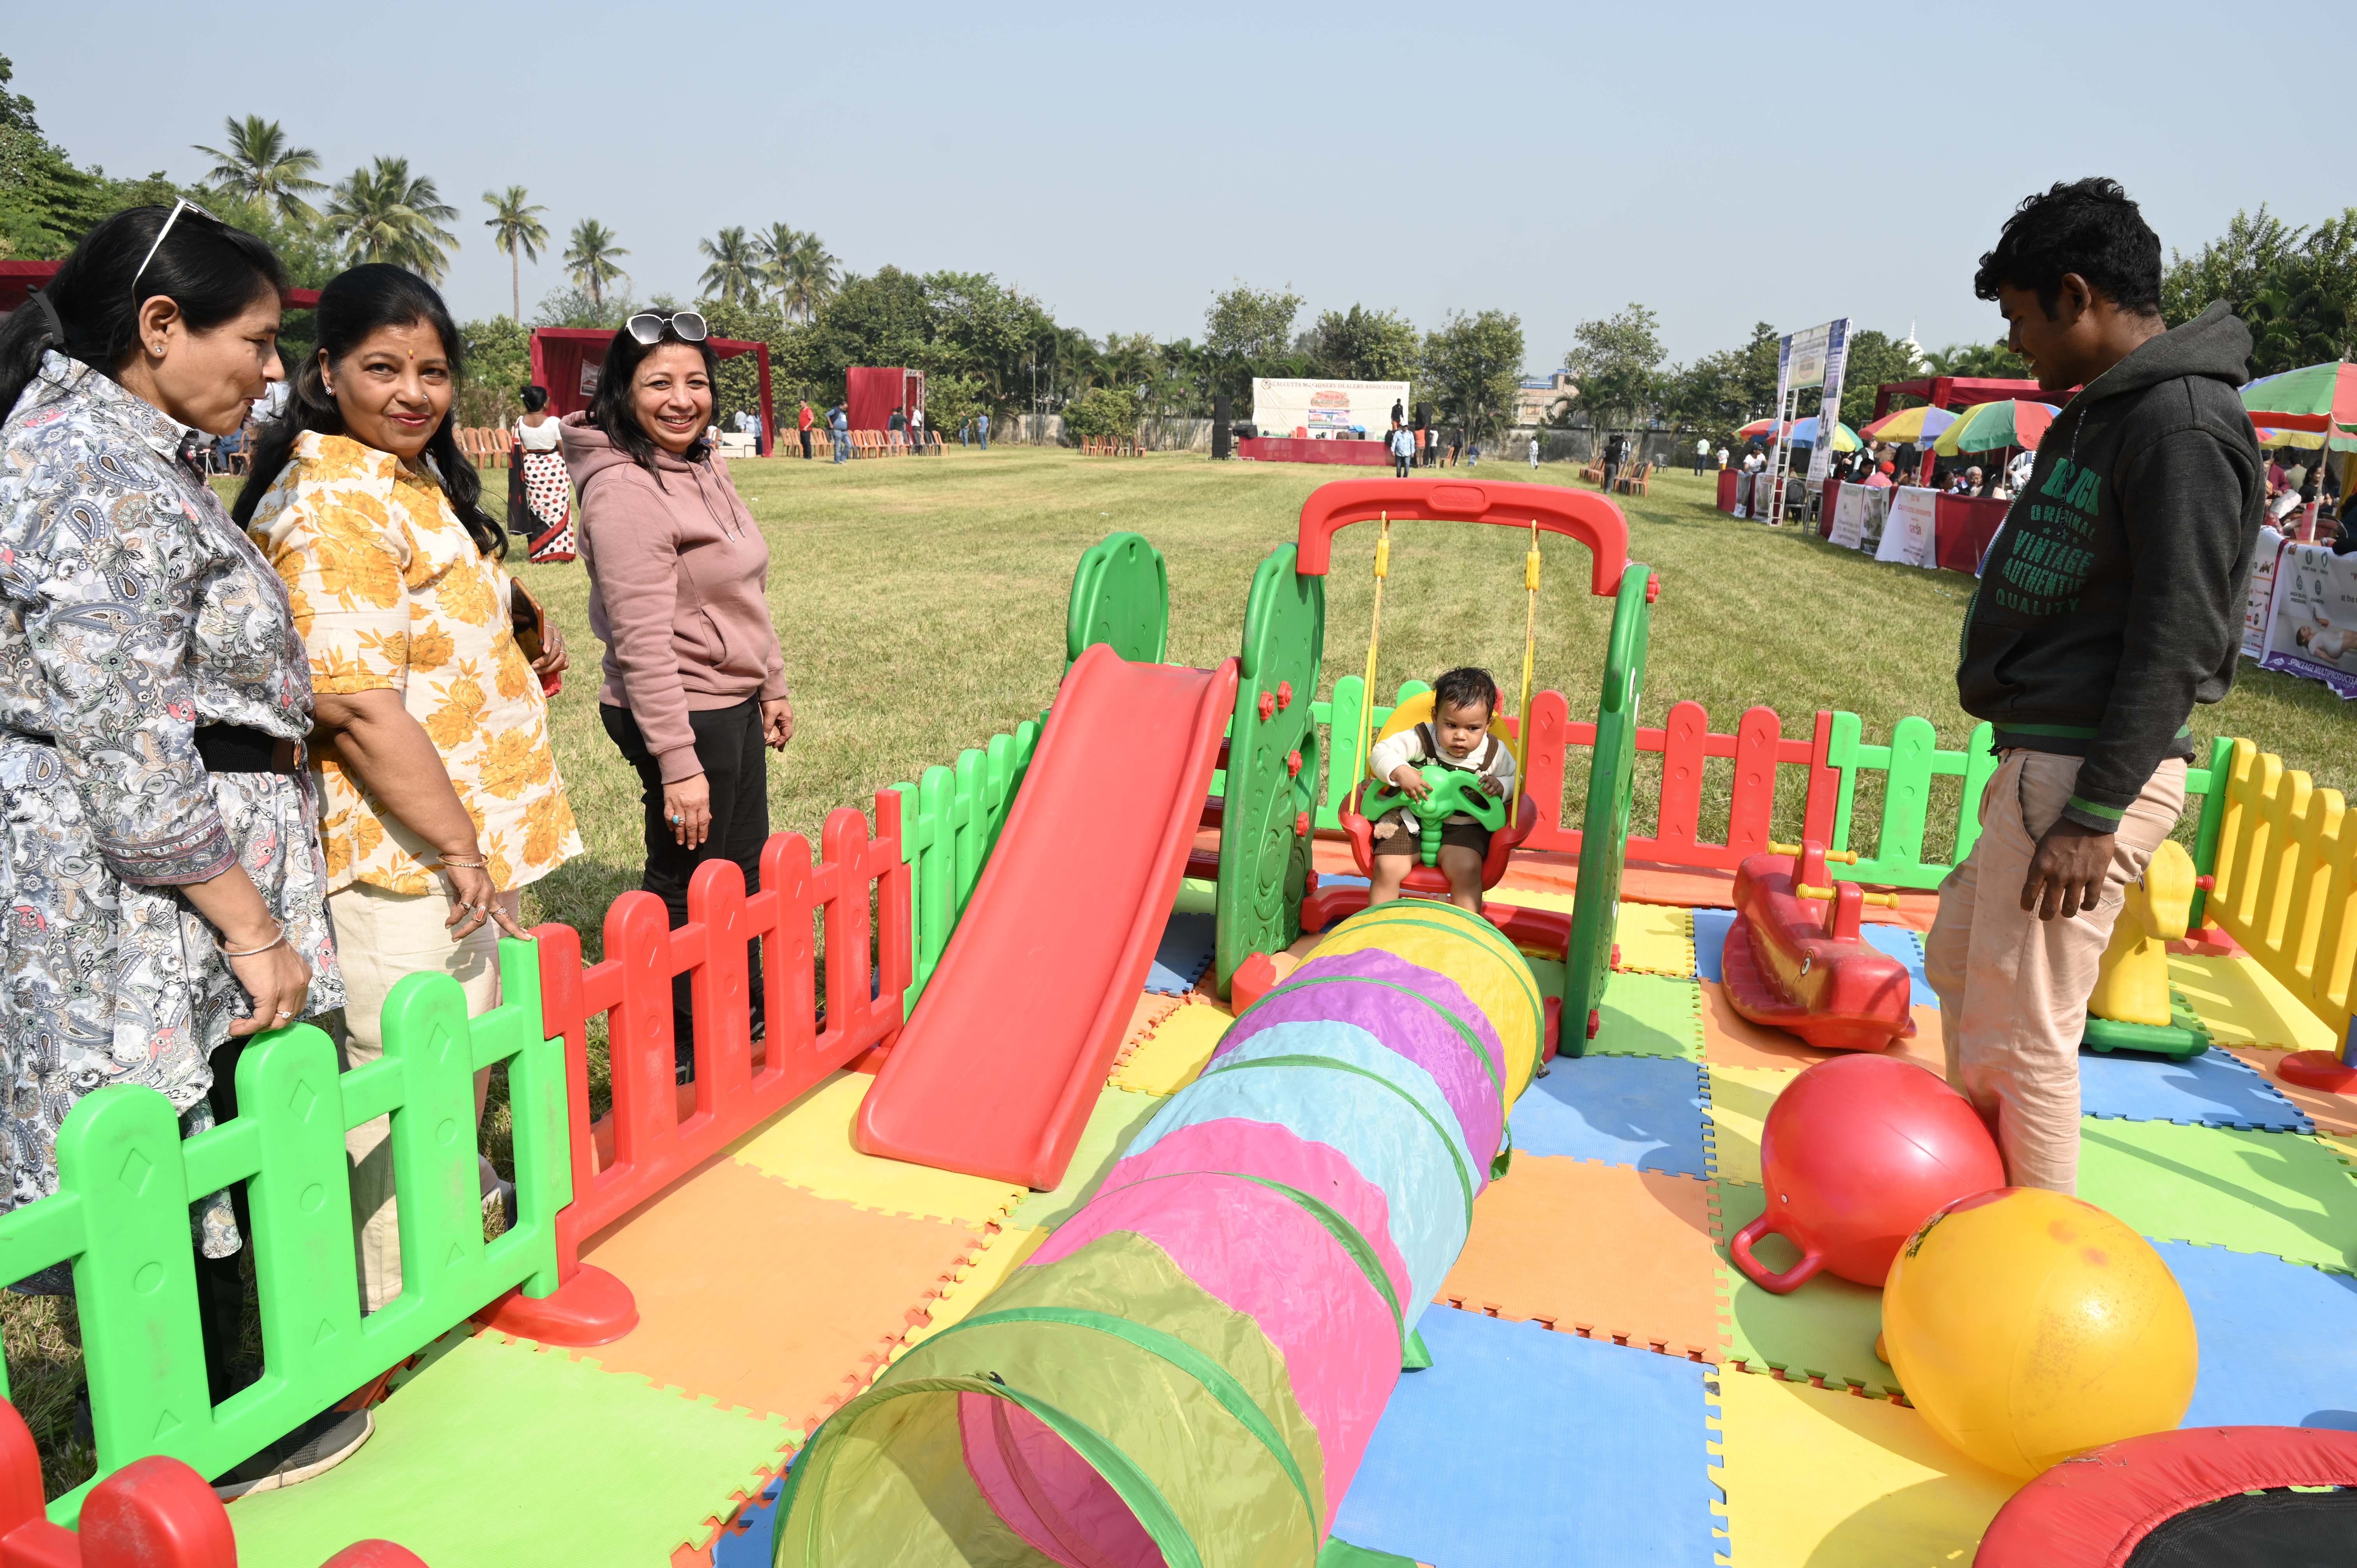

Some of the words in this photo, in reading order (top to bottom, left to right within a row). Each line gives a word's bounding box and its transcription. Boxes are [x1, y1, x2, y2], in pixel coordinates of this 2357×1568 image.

[2031, 505, 2096, 542] ORIGINAL
[2013, 530, 2094, 577] VINTAGE
[2002, 557, 2087, 597] AUTHENTIC
[1996, 588, 2080, 616] QUALITY
[2288, 659, 2315, 673] SPACEAGE
[2314, 666, 2354, 684] MULTIPRODUCTS
